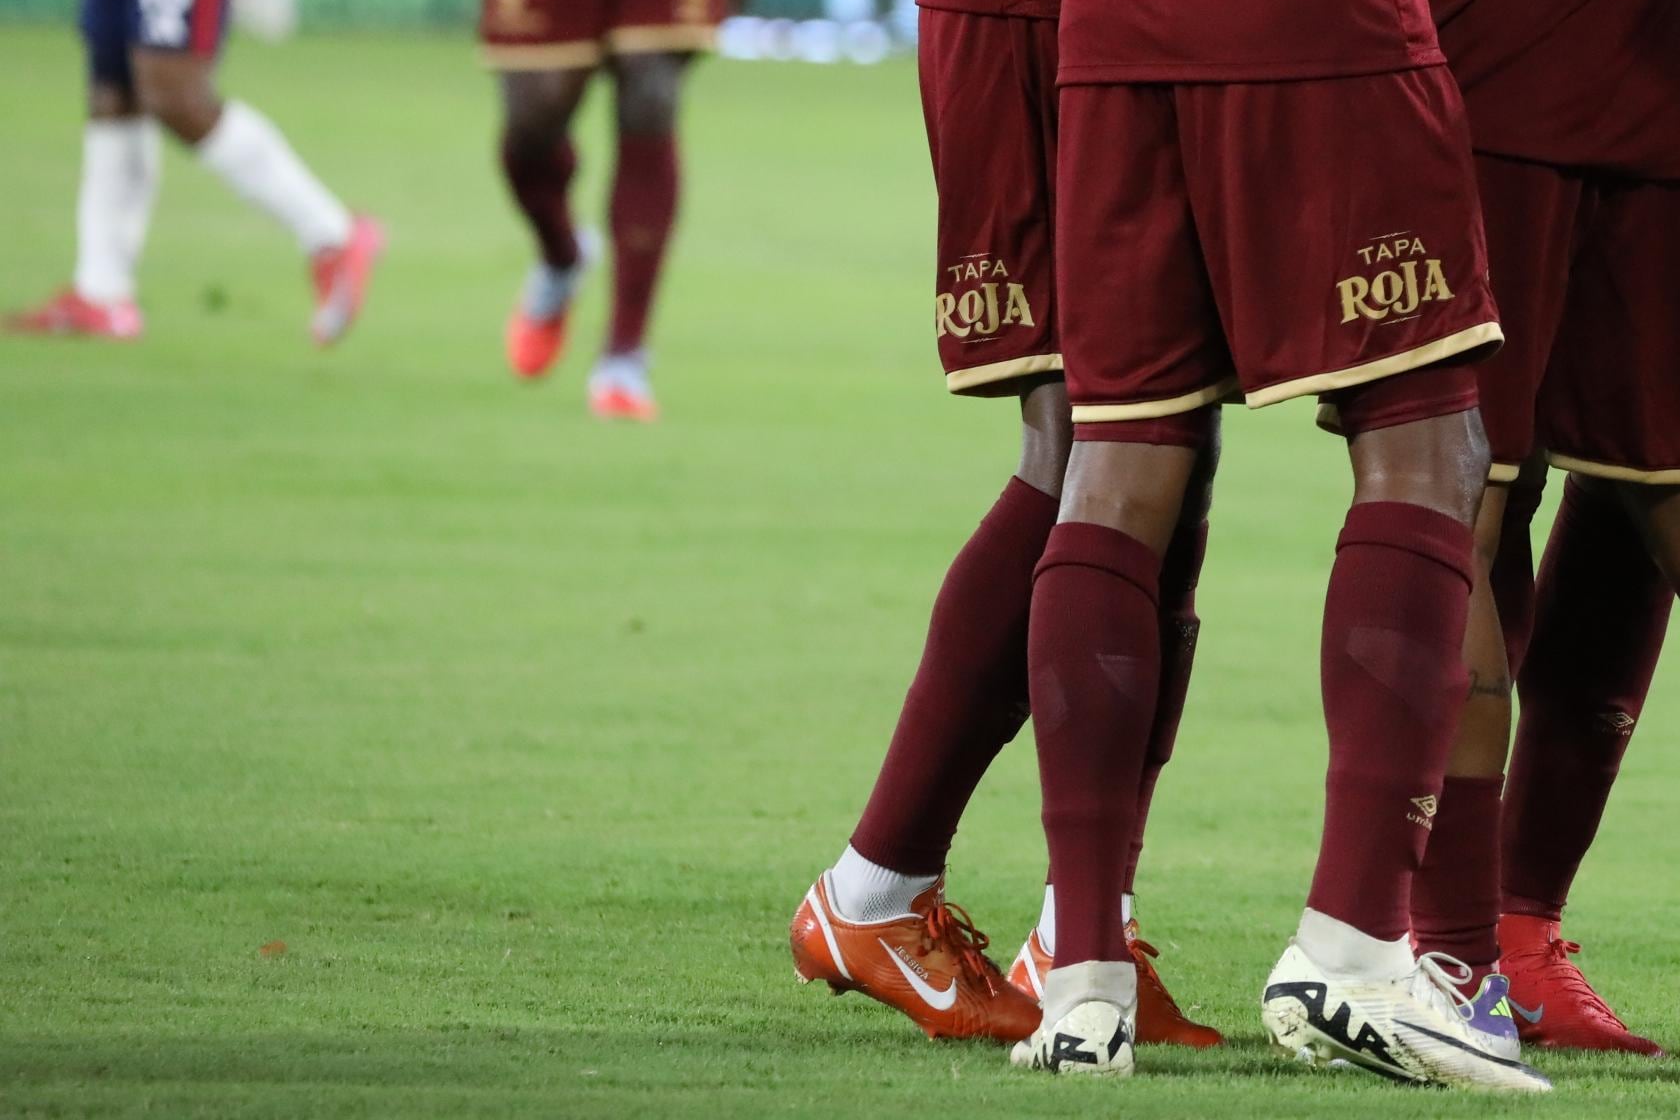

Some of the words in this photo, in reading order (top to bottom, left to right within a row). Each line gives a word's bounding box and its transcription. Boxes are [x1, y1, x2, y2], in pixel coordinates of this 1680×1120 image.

[948, 259, 1009, 282] TAPA
[1356, 237, 1426, 265] TAPA
[936, 282, 1035, 338] ROJA
[1336, 259, 1456, 325] ROJA
